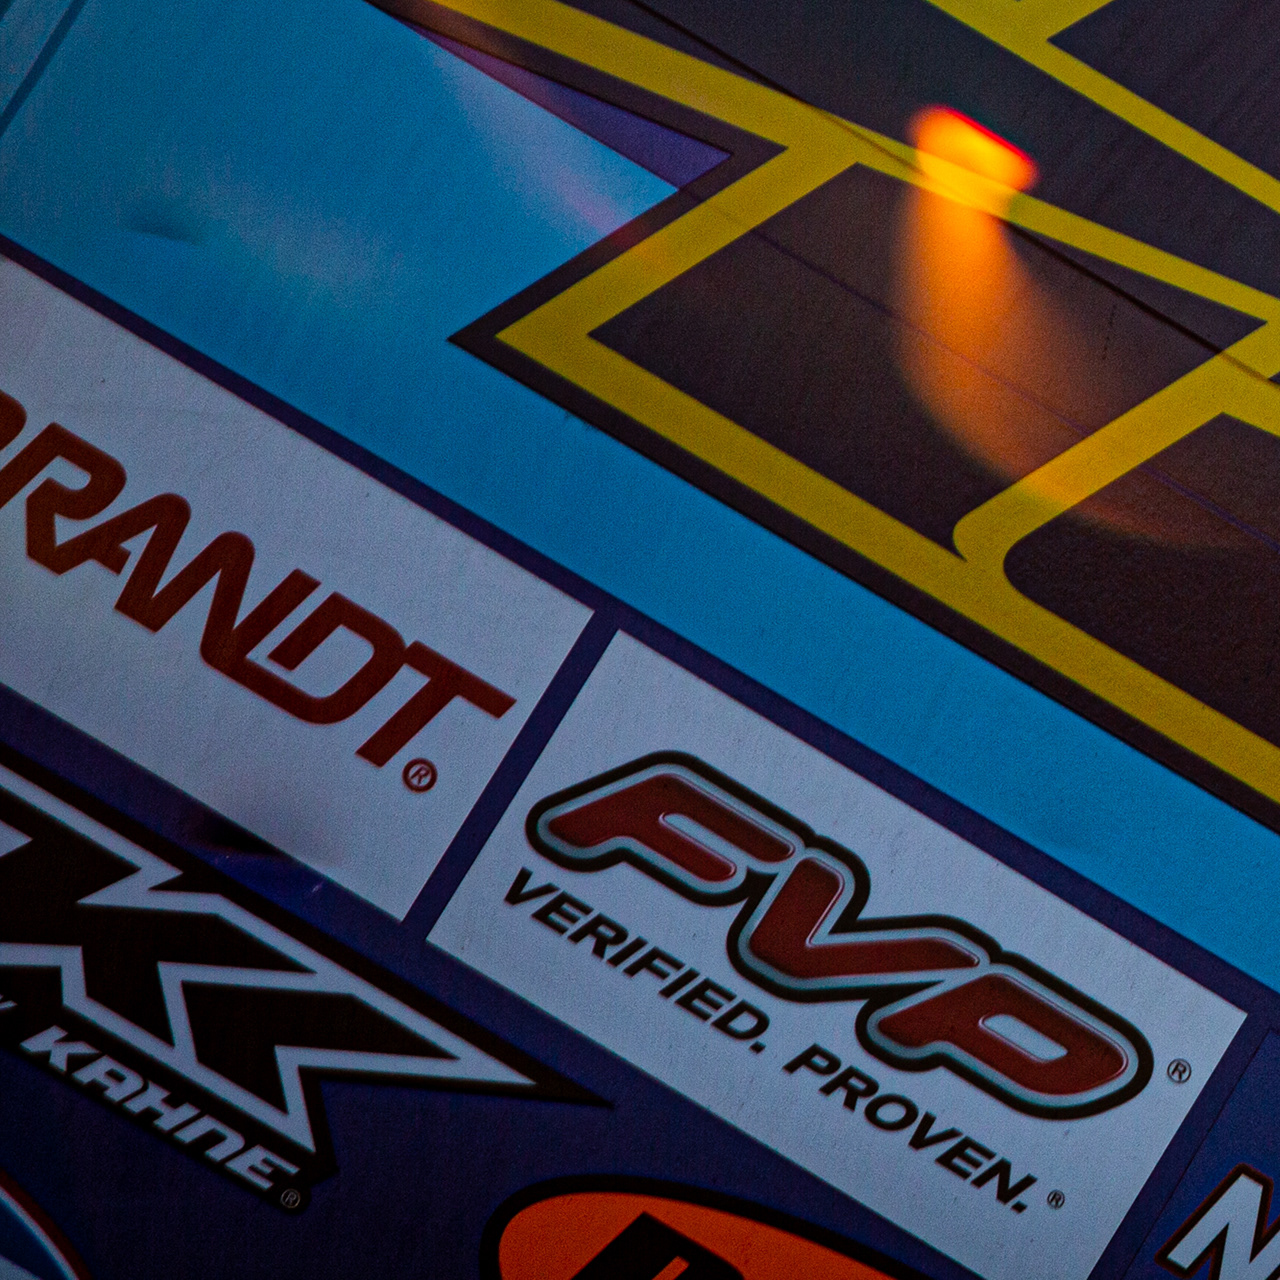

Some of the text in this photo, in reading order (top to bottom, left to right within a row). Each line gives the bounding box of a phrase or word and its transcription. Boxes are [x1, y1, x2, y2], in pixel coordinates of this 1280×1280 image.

[20, 1025, 299, 1189] KAHNE
[503, 866, 1038, 1212] VERIFIED. PROVEN.
[526, 749, 1154, 1120] FVP
